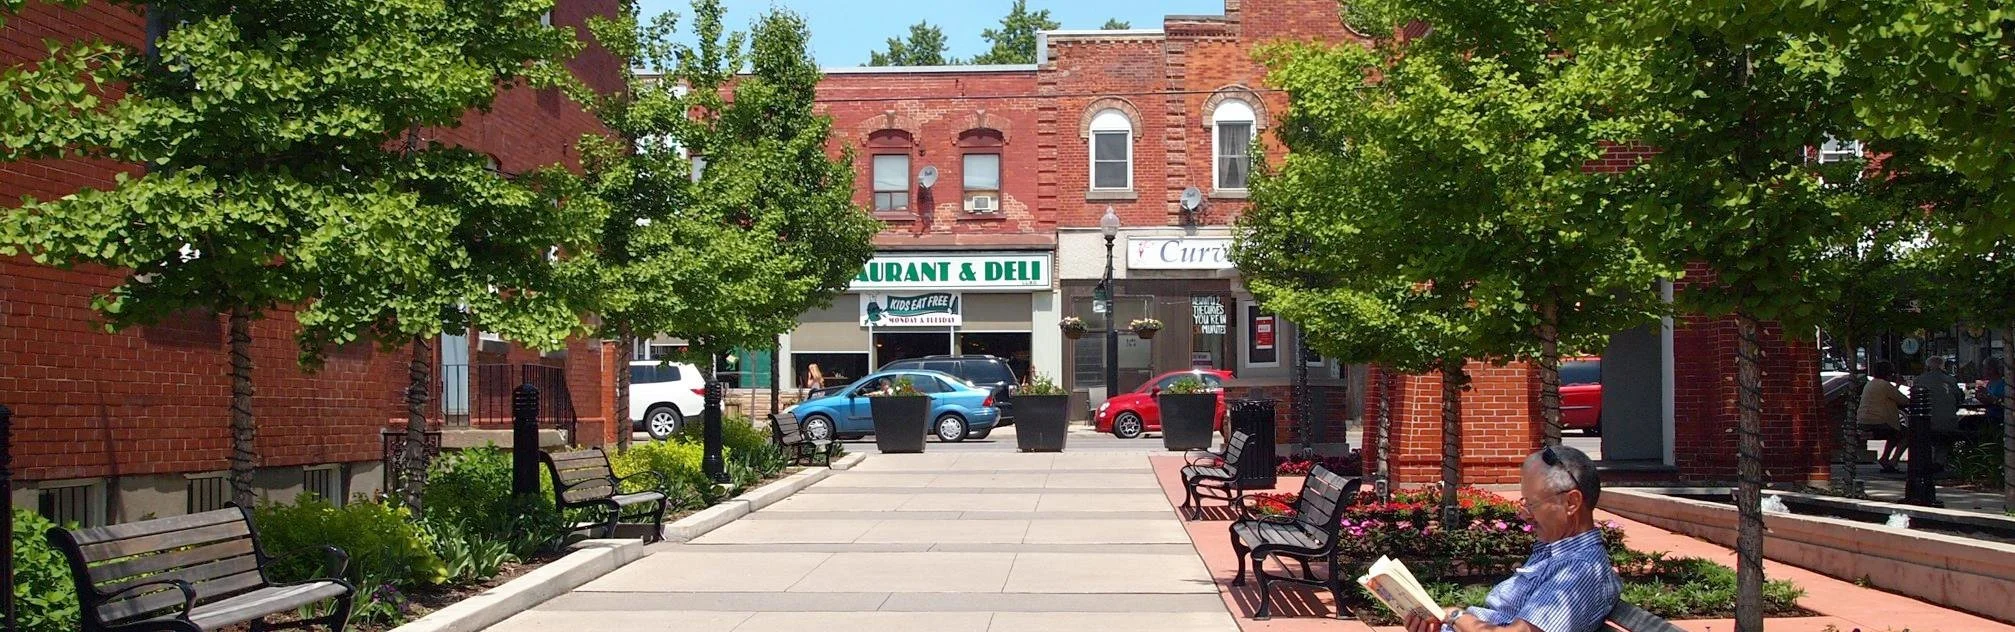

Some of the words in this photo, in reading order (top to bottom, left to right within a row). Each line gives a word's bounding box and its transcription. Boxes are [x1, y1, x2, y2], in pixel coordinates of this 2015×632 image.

[959, 262, 976, 282] &
[985, 261, 1041, 281] DELI
[890, 299, 911, 311] KIDS
[911, 297, 928, 311] EAT
[1202, 325, 1227, 334] MINUTES
